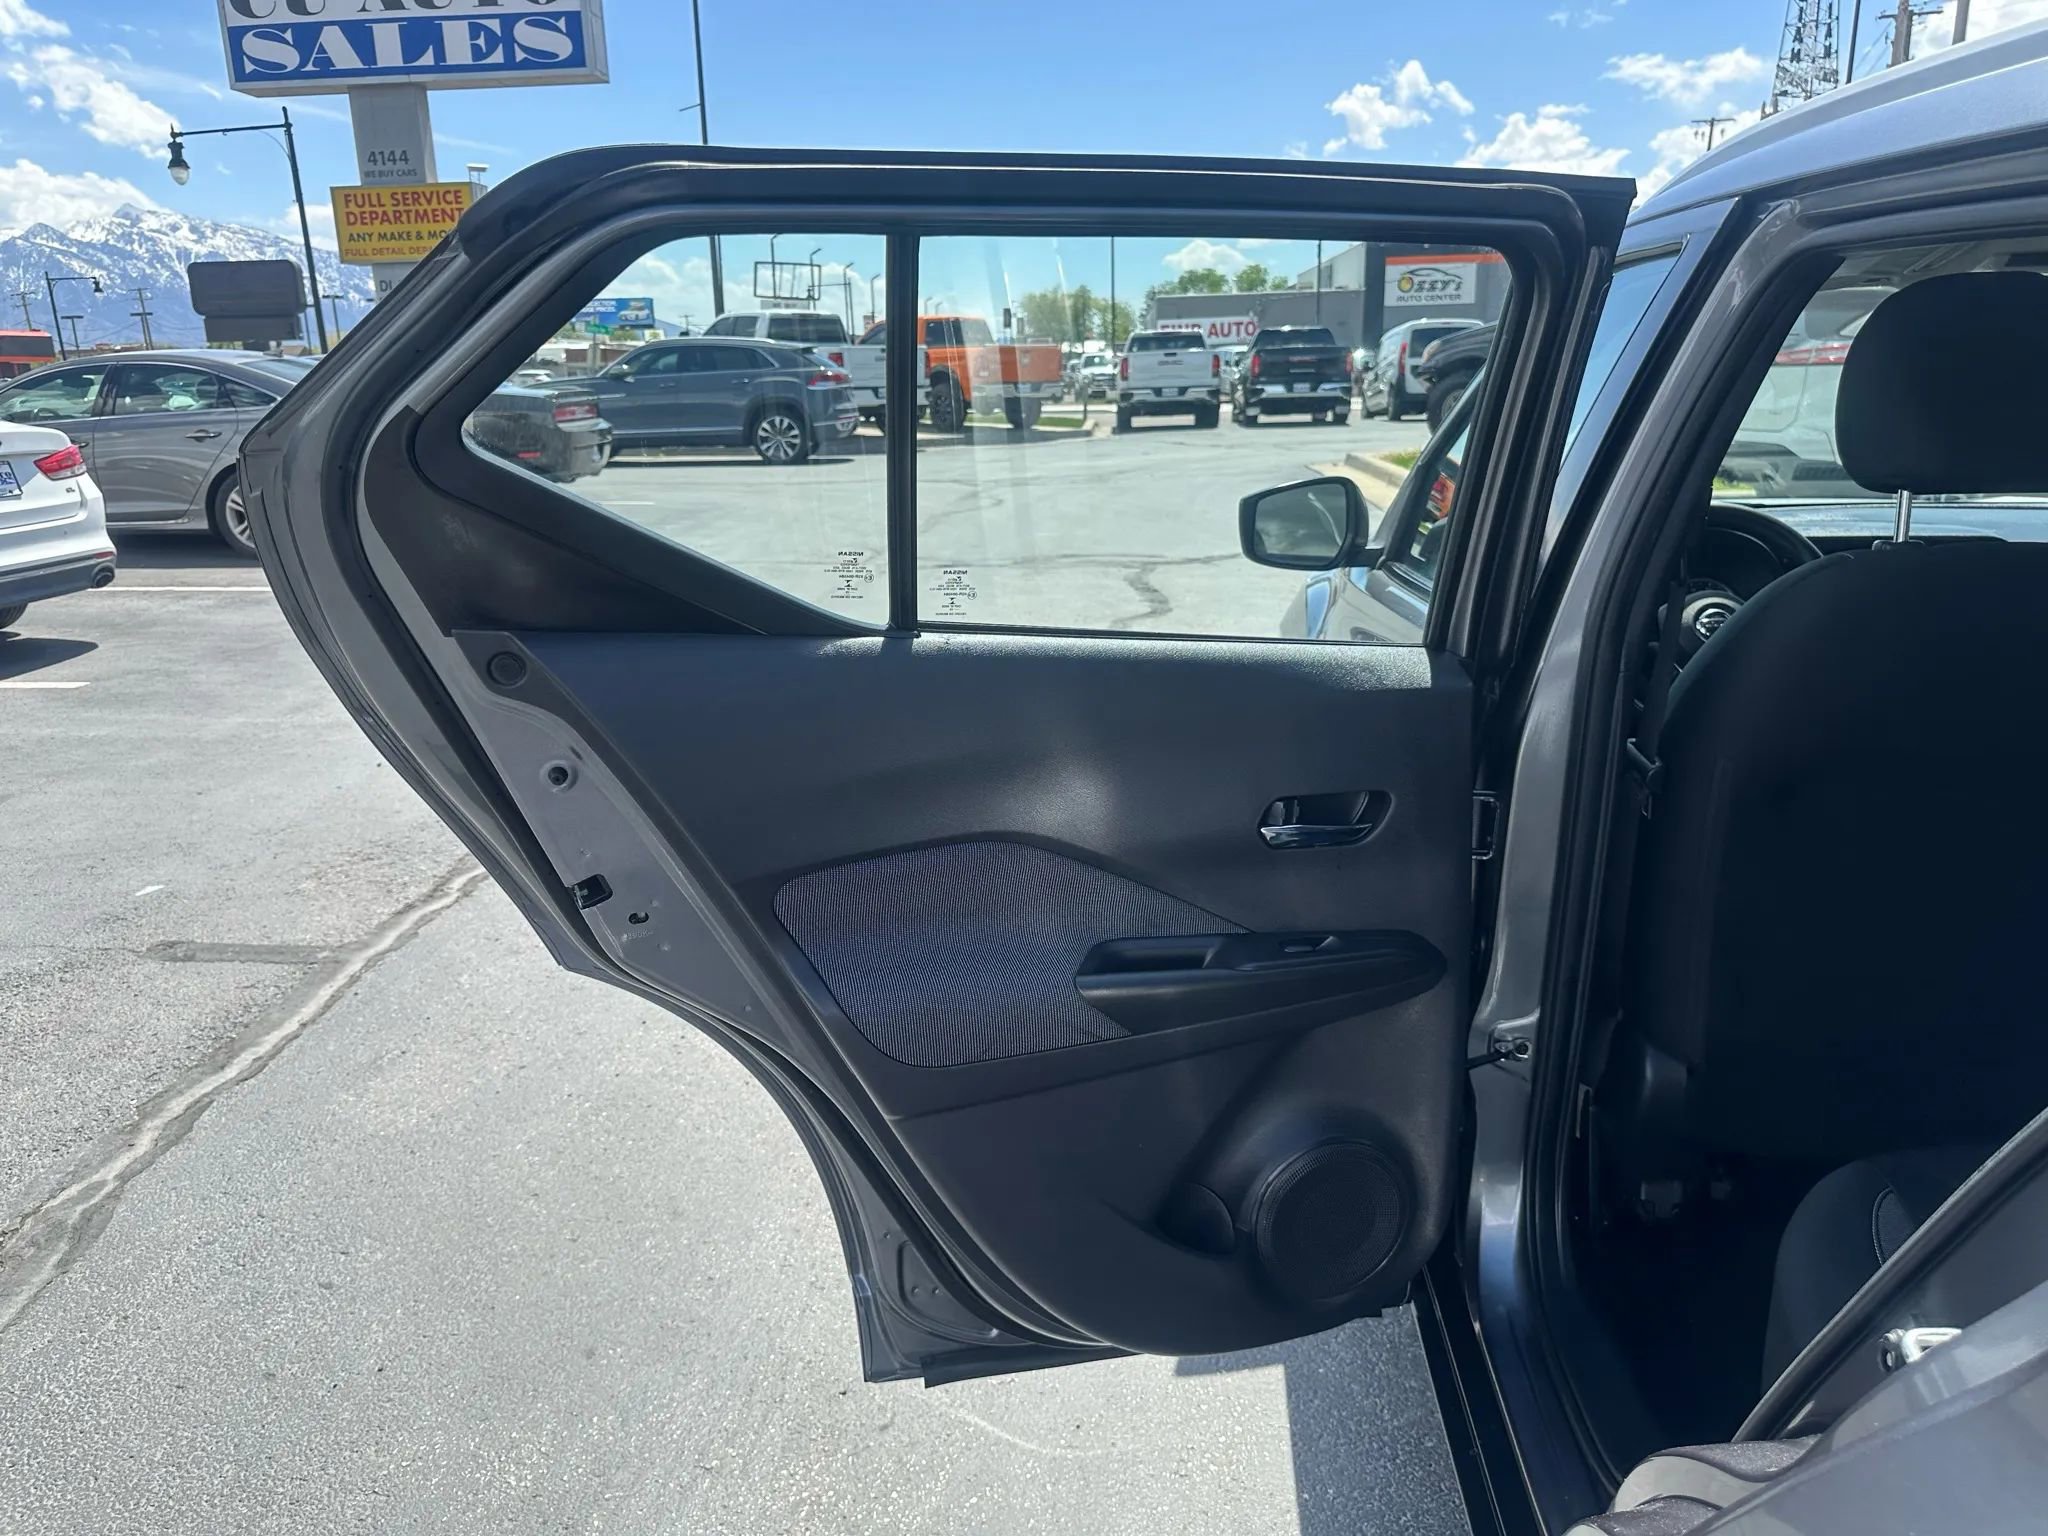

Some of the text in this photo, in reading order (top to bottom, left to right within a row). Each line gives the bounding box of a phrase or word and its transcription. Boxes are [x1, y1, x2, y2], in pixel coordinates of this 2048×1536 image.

[241, 16, 574, 74] SALES
[368, 150, 409, 166] 4144
[378, 169, 394, 178] BUY
[396, 168, 417, 177] CARS
[344, 190, 463, 208] FULL SERVICE
[345, 208, 464, 226] DEPARTMENT
[348, 232, 374, 242] ANY
[378, 231, 412, 241] MAKE
[416, 231, 423, 240] &
[372, 247, 405, 256] DETAIL
[1397, 294, 1461, 303] AUTO CENTER
[1208, 322, 1257, 338] AUTO
